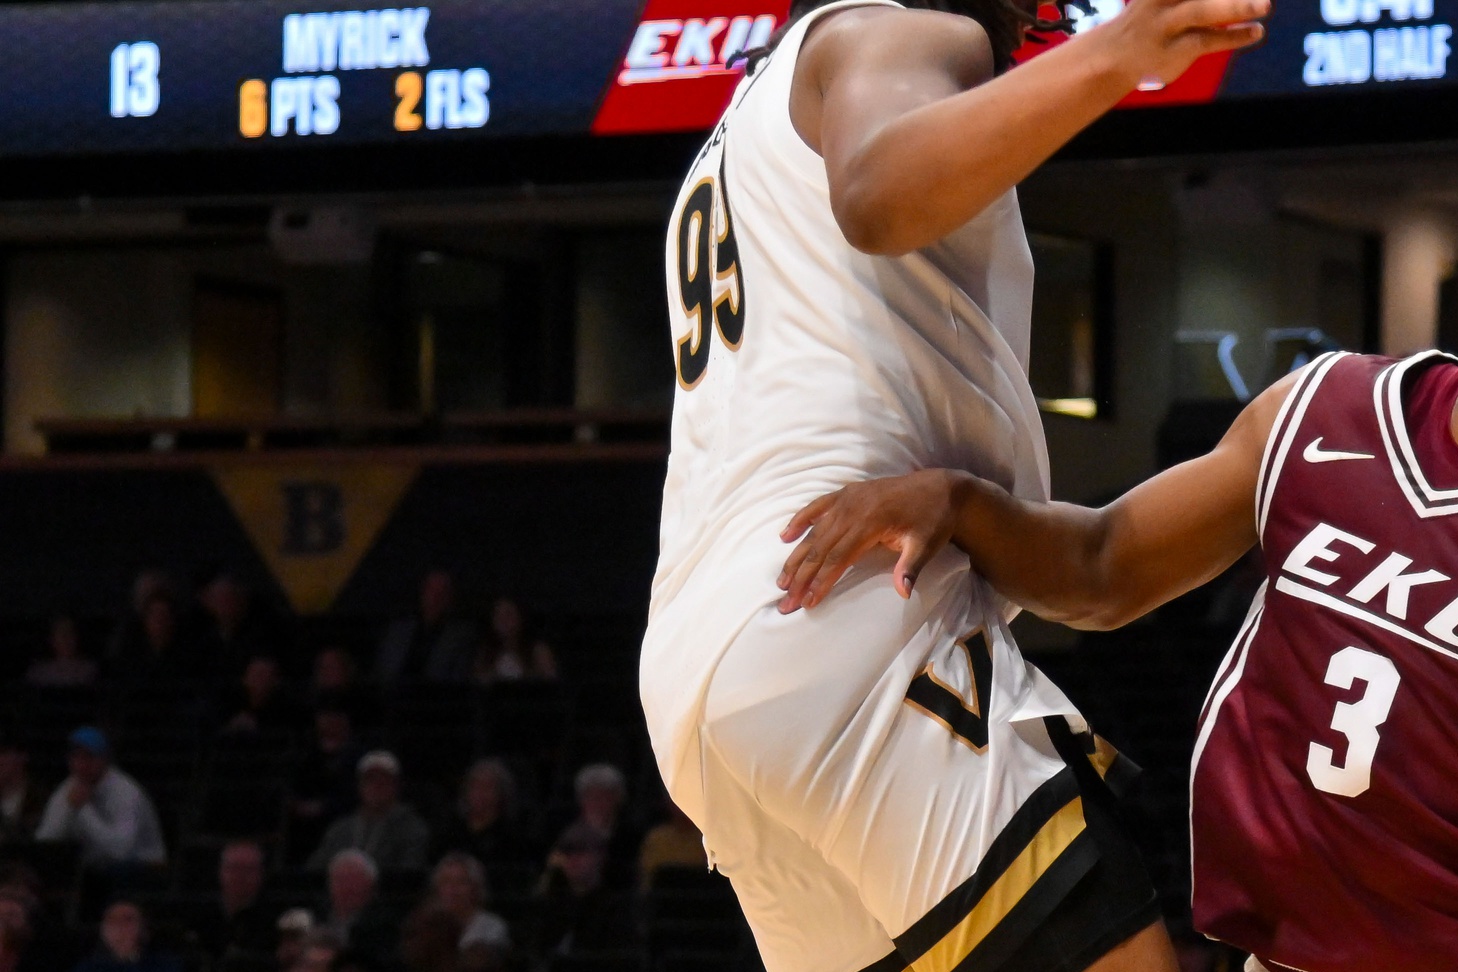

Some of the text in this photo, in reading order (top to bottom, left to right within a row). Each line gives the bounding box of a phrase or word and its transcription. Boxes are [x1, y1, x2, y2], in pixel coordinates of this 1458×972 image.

[283, 7, 430, 73] MYRICK
[1302, 24, 1453, 86] 2ND HALF
[110, 41, 160, 118] 13
[239, 67, 490, 138] 6 PTS 2 FLS
[1306, 645, 1401, 798] 3
